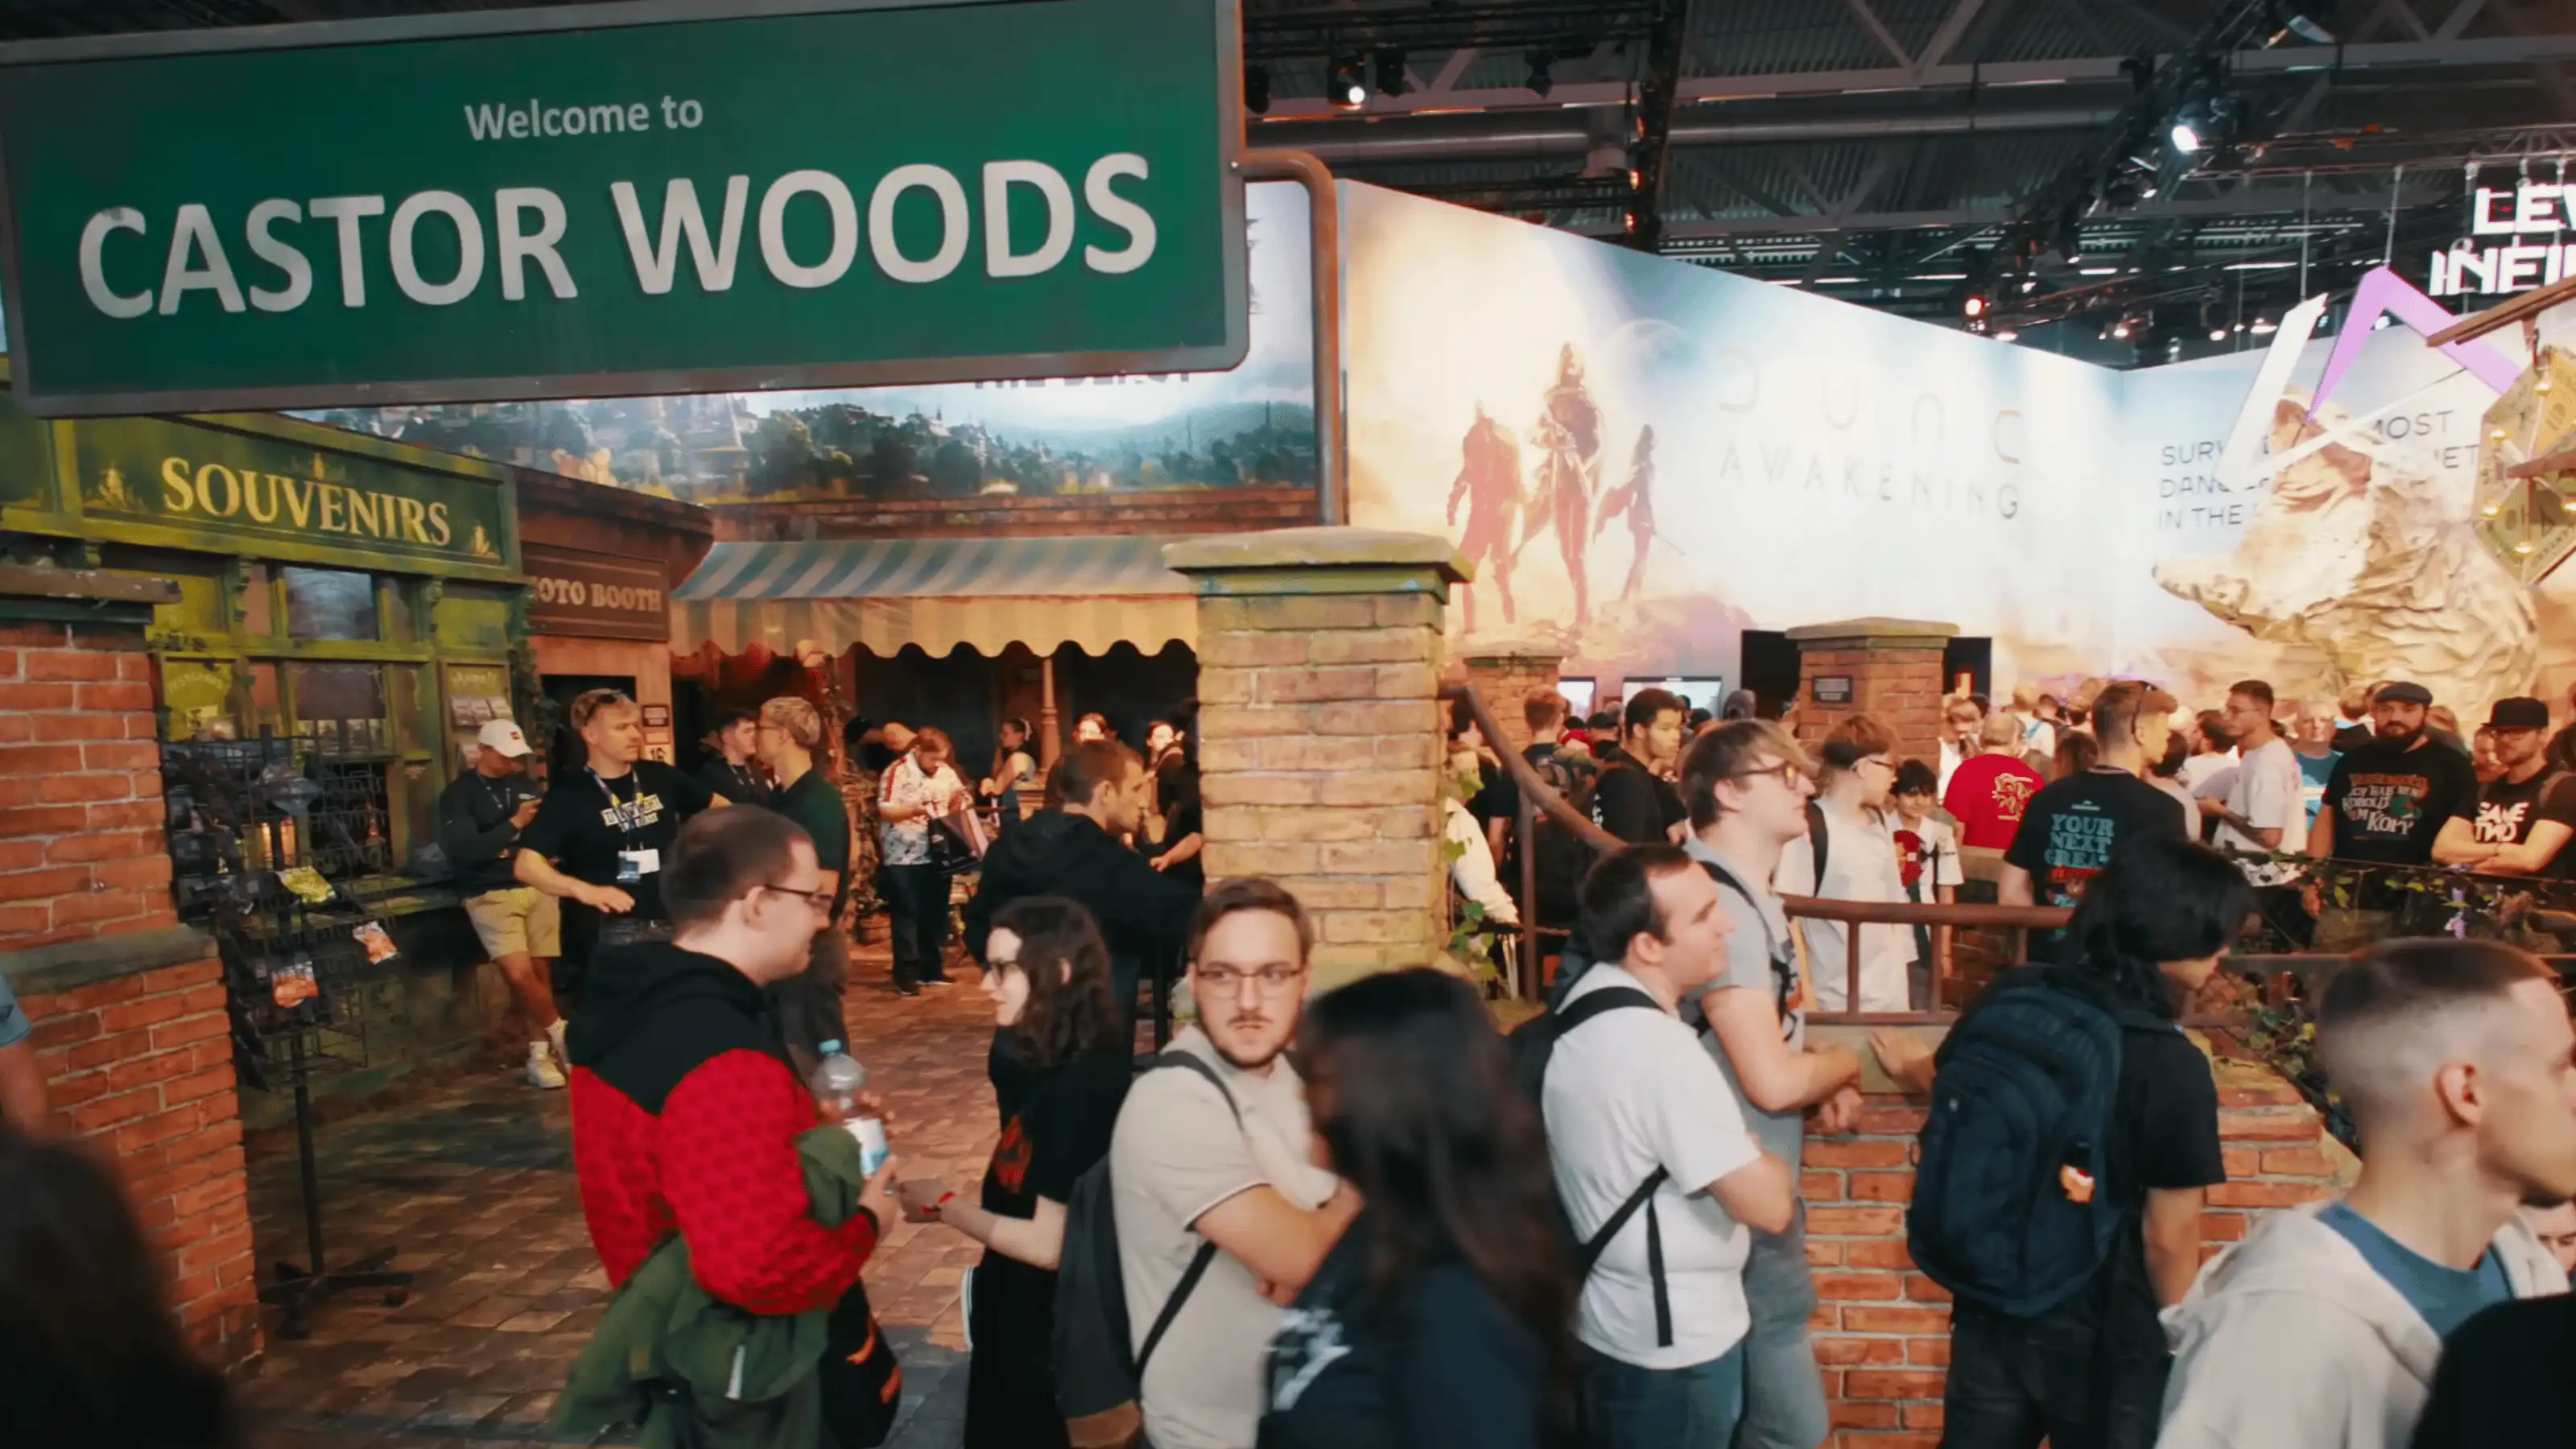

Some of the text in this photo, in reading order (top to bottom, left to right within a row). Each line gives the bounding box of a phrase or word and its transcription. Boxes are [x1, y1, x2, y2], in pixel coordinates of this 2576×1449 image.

[464, 94, 704, 141] Welcome to
[78, 151, 1158, 320] CASTOR WOODS
[1719, 439, 2019, 520] AWAKENING
[161, 456, 451, 547] SOUVENIRS
[2158, 503, 2244, 531] IN THE
[589, 582, 663, 613] BOOTH
[2050, 832, 2112, 854] NEXT
[2051, 813, 2115, 838] YOUR
